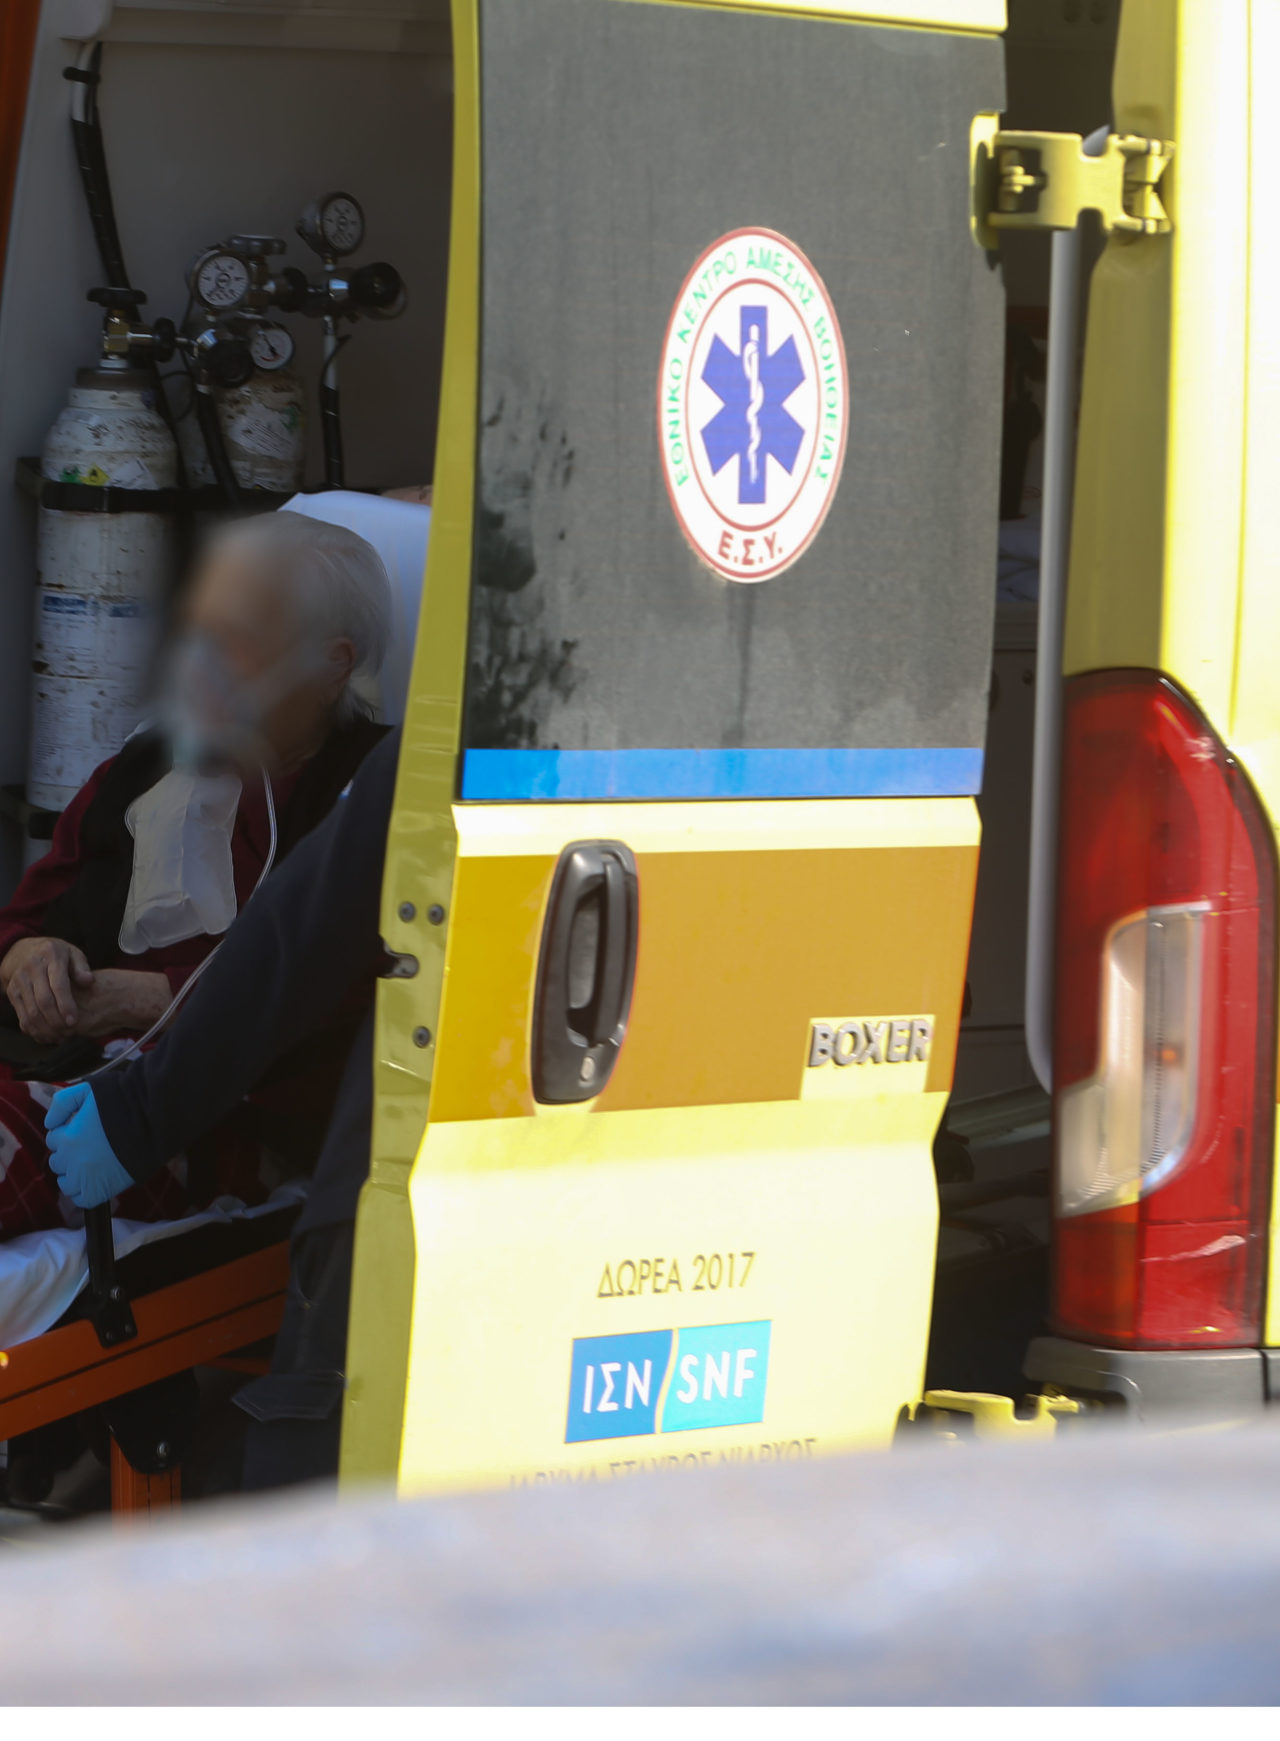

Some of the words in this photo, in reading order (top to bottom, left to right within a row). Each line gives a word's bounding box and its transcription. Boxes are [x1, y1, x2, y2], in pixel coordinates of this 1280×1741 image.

[677, 251, 737, 343] ΚΕΝΤΡΟ
[746, 247, 816, 312] ΑΜΕΣΗΣ
[717, 530, 784, 566] Ε.Σ.Υ.
[808, 1019, 932, 1067] BOXER
[597, 1257, 682, 1298] ΔΩΡΕΑ
[692, 1251, 756, 1291] 2017
[582, 1359, 652, 1414] ΙΣΝ
[676, 1348, 758, 1404] SNF
